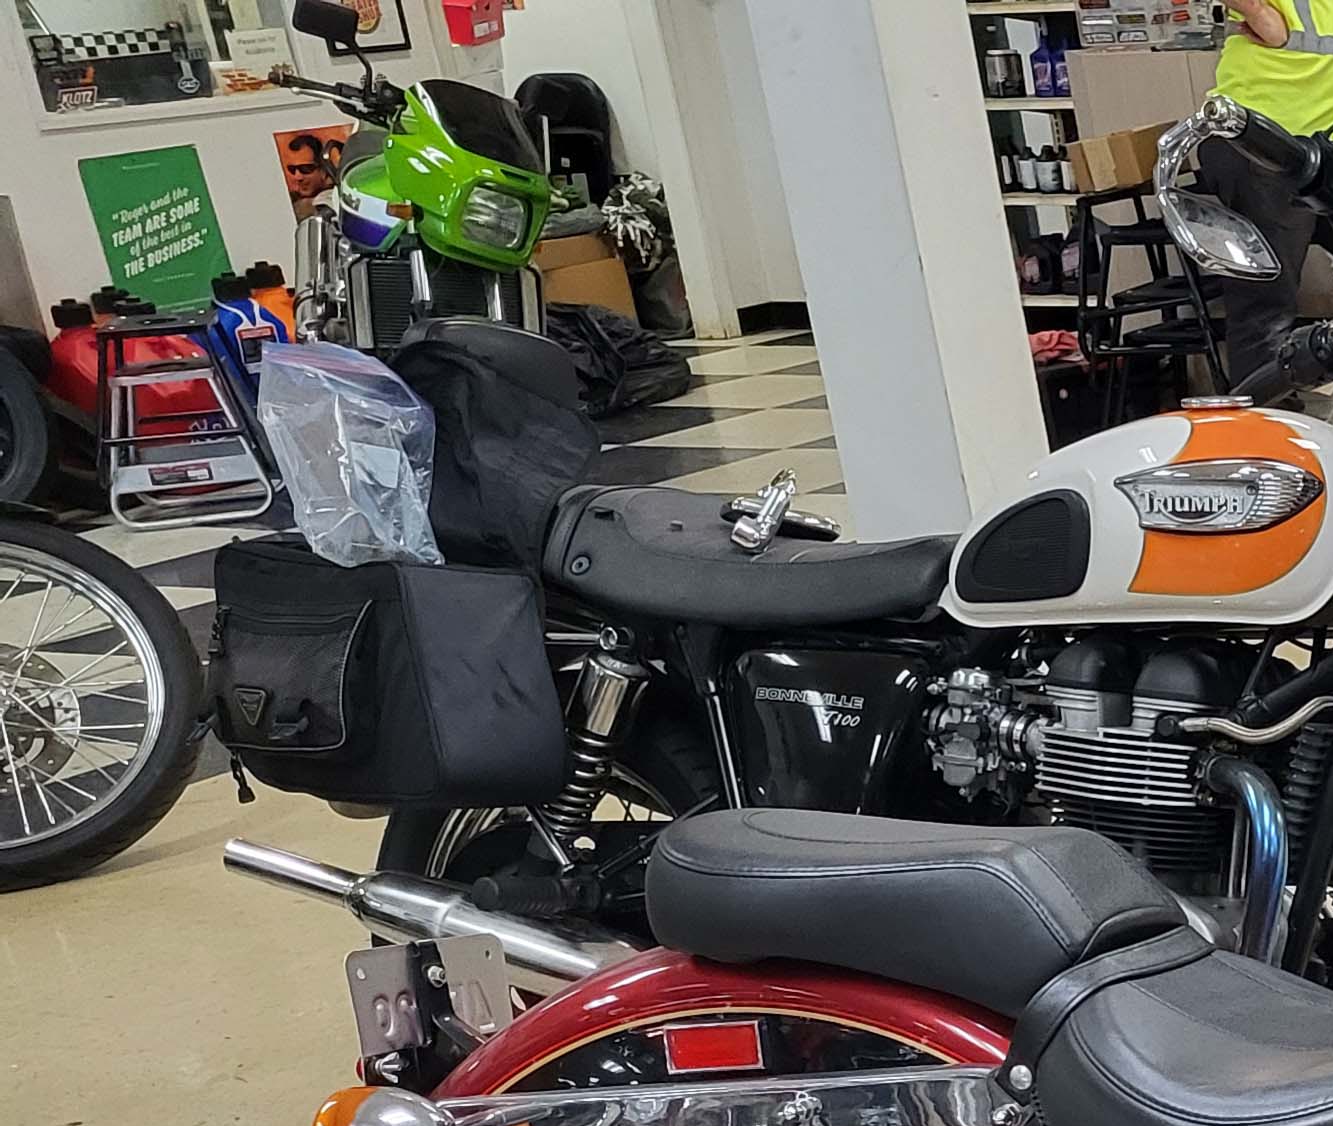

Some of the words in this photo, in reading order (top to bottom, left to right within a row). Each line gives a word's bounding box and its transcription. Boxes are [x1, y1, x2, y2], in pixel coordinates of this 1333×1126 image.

[61, 90, 93, 104] KLOTZ
[149, 192, 172, 211] and
[172, 187, 189, 202] the
[112, 223, 143, 248] TEAM
[145, 212, 168, 233] ARE
[169, 197, 201, 224] SOME
[129, 242, 141, 258] of
[142, 233, 160, 251] the
[160, 225, 180, 242] best
[181, 220, 192, 233] in
[123, 258, 146, 278] THE
[1142, 491, 1244, 514] TRIUMPH
[755, 687, 865, 710] BONNEVILLE
[823, 710, 861, 728] T100
